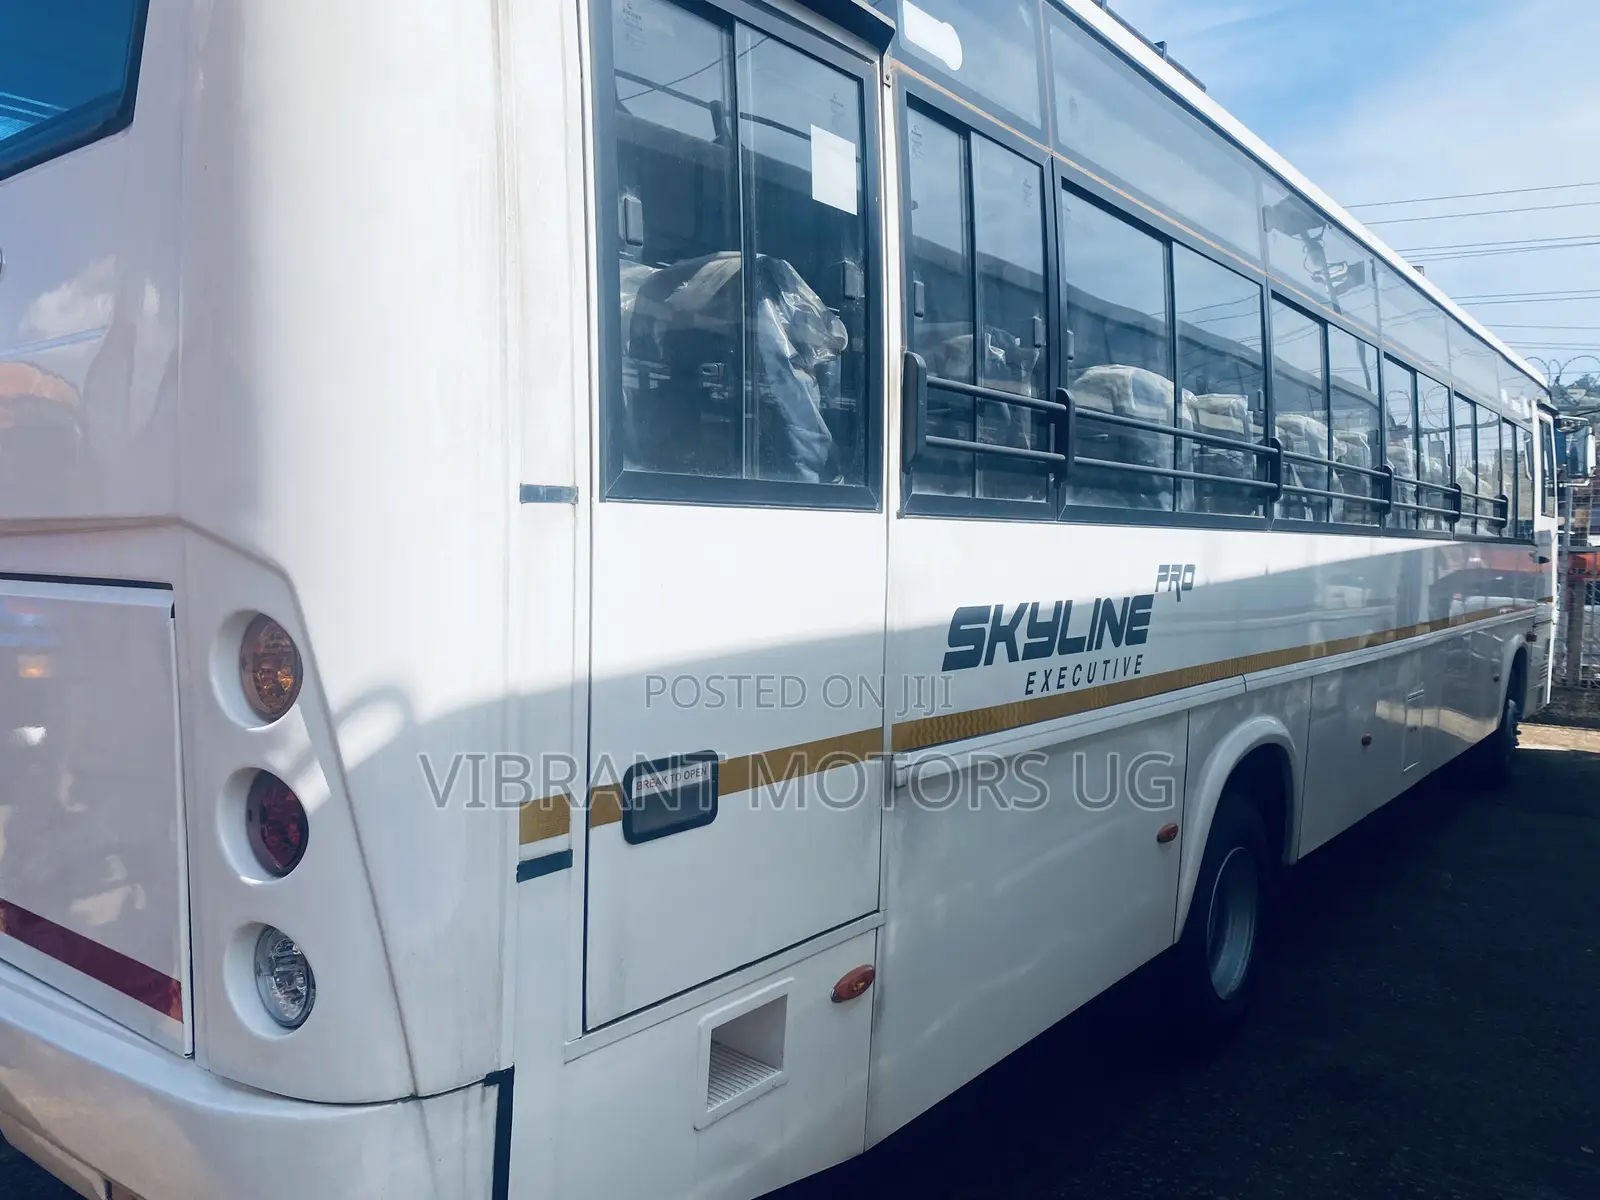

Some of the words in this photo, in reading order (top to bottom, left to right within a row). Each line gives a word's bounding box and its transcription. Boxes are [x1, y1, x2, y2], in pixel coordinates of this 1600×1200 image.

[1155, 564, 1196, 602] PRO
[941, 594, 1155, 672] SKYLINE
[1024, 654, 1144, 696] EXECUTIVE
[636, 776, 668, 790] BREAK
[671, 773, 682, 784] TO
[683, 767, 707, 780] OPEN
